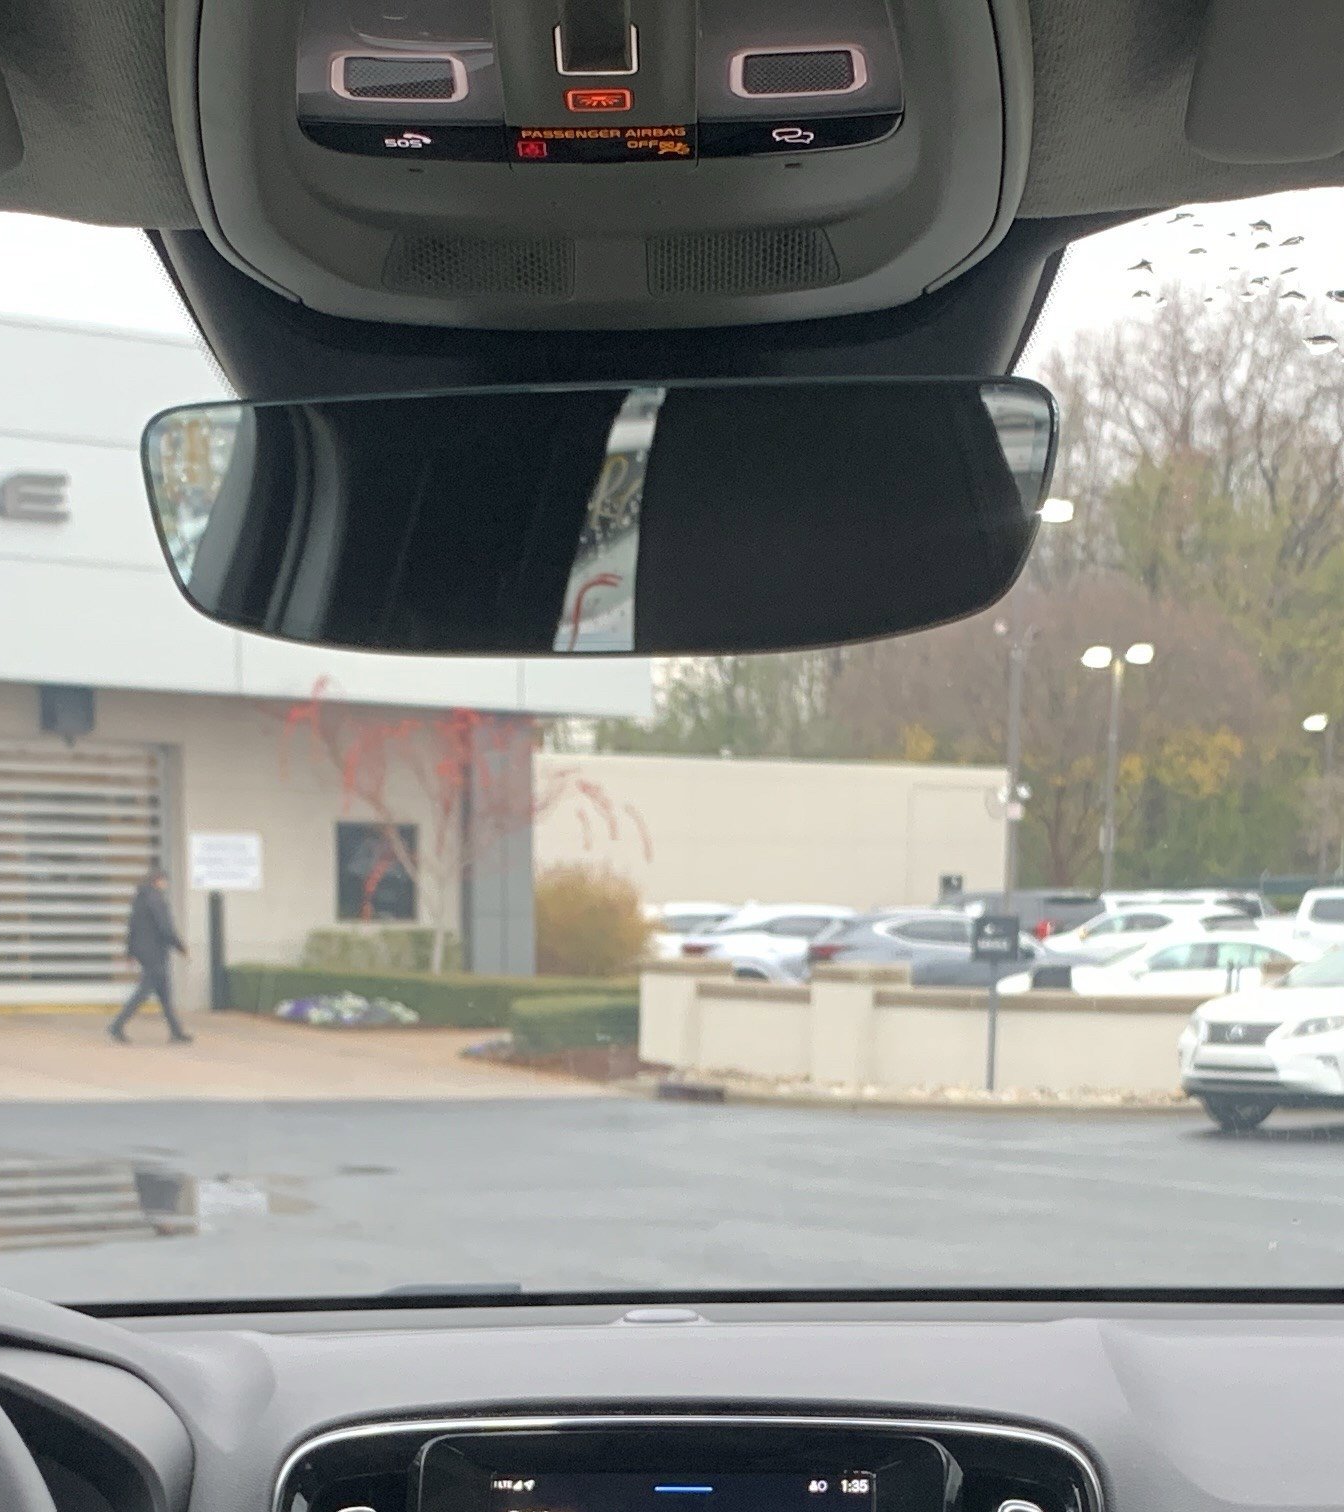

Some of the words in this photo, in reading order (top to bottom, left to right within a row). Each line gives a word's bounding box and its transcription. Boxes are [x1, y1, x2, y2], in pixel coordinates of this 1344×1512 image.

[521, 129, 620, 139] PASSENGER
[625, 127, 686, 138] AIRBAG
[385, 138, 423, 148] SOS
[627, 140, 658, 149] OFF
[840, 1479, 869, 1493] 1:35
